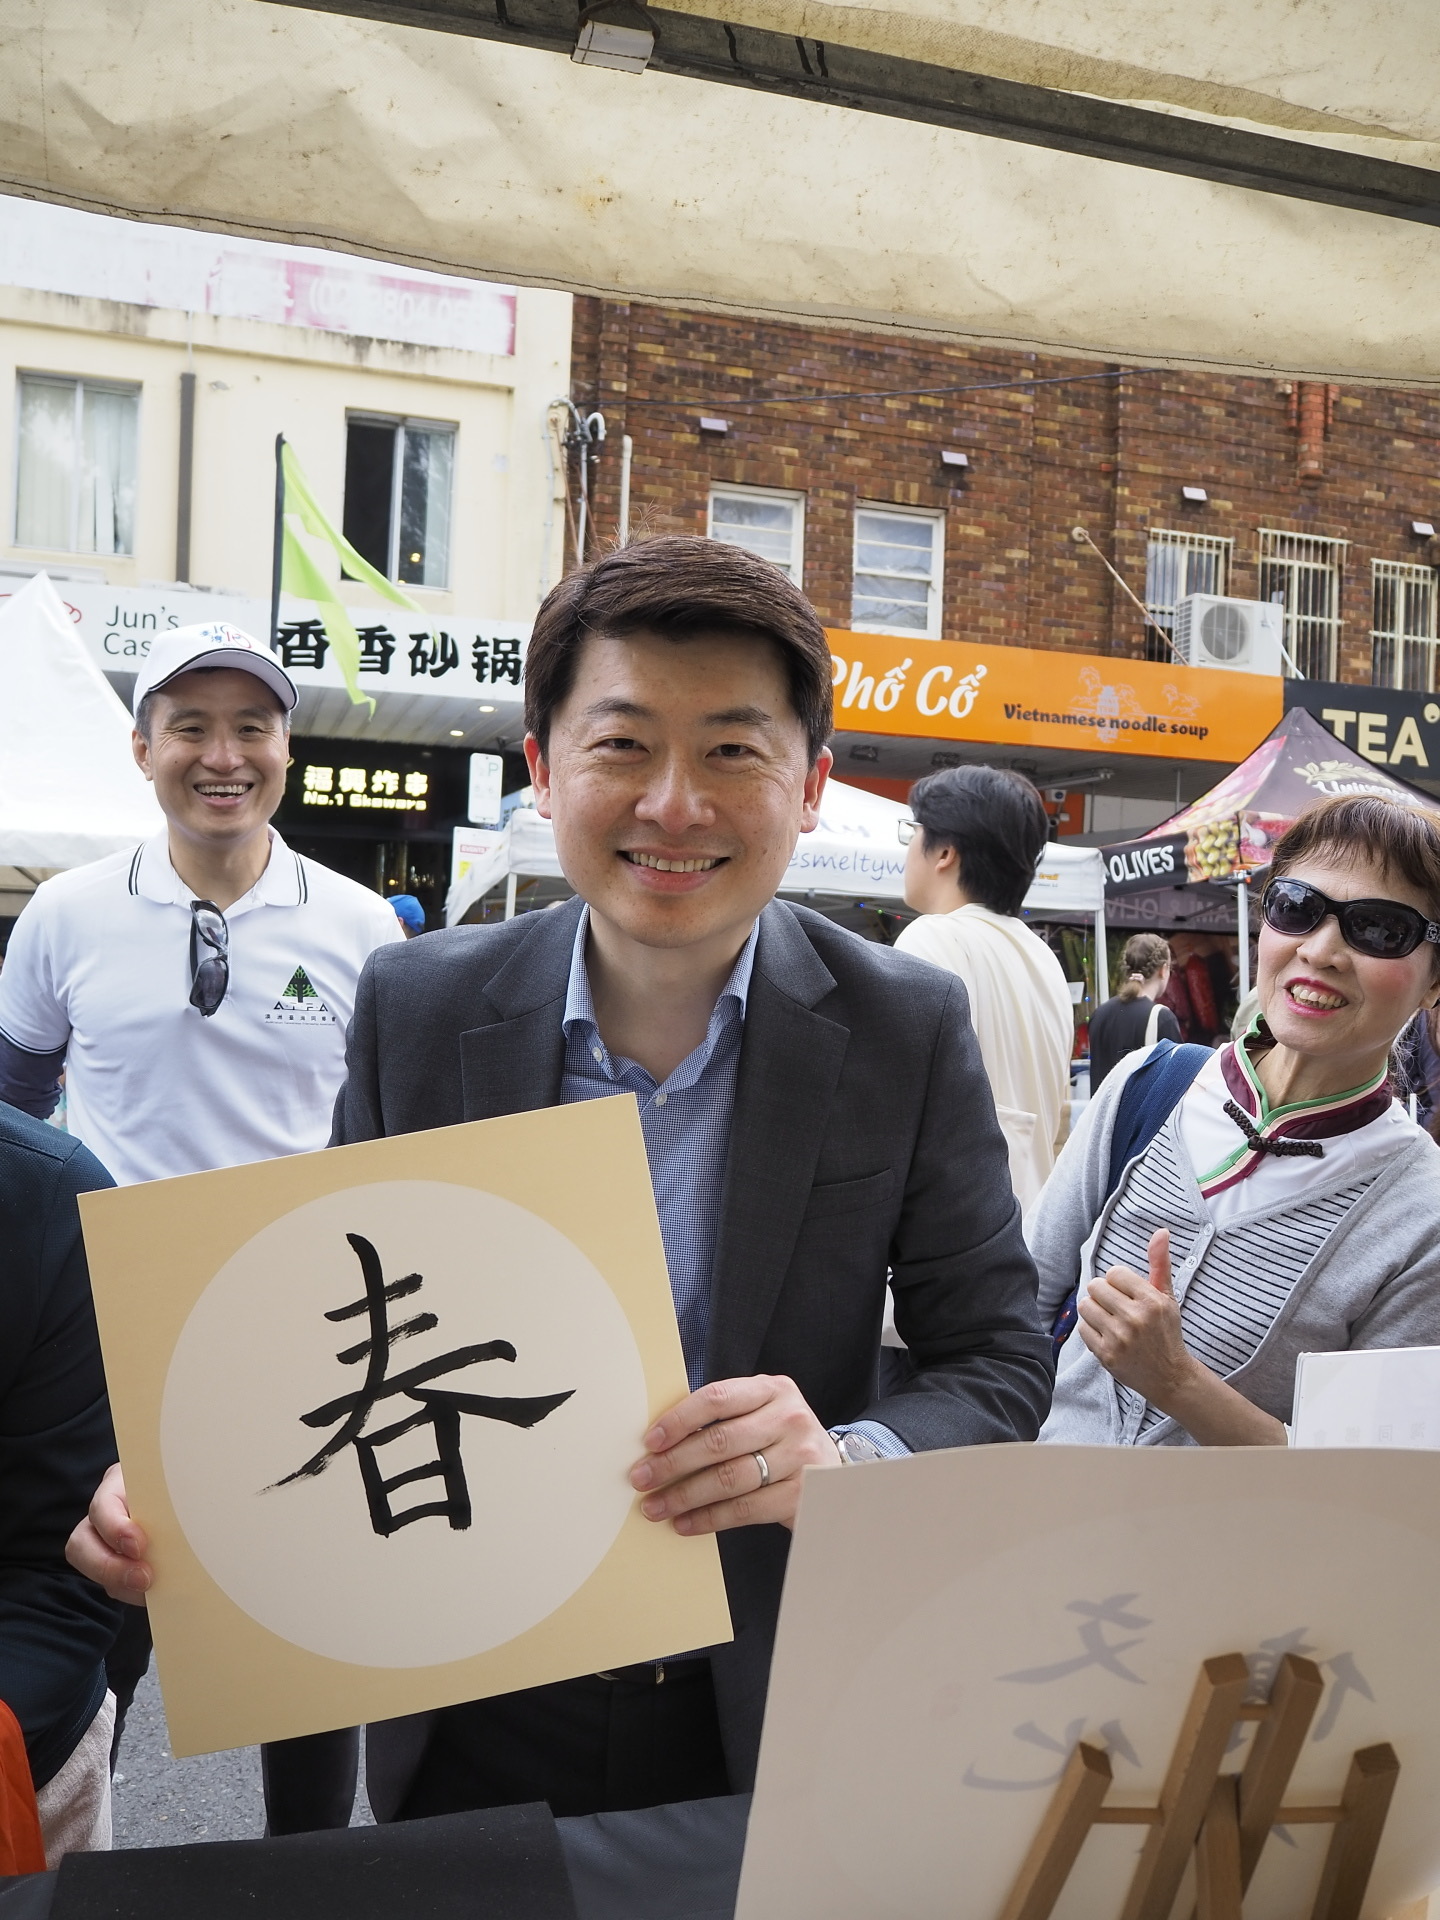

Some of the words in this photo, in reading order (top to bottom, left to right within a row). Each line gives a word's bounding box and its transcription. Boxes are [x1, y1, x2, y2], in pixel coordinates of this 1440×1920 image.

[105, 605, 179, 631] Jun's
[916, 664, 988, 719] Cổ
[1004, 703, 1106, 728] Vietnamese
[1110, 716, 1167, 733] noodle
[1170, 722, 1209, 740] soup
[1321, 708, 1430, 768] TEA
[1109, 845, 1175, 883] OLIVES
[254, 1232, 577, 1538] 春
